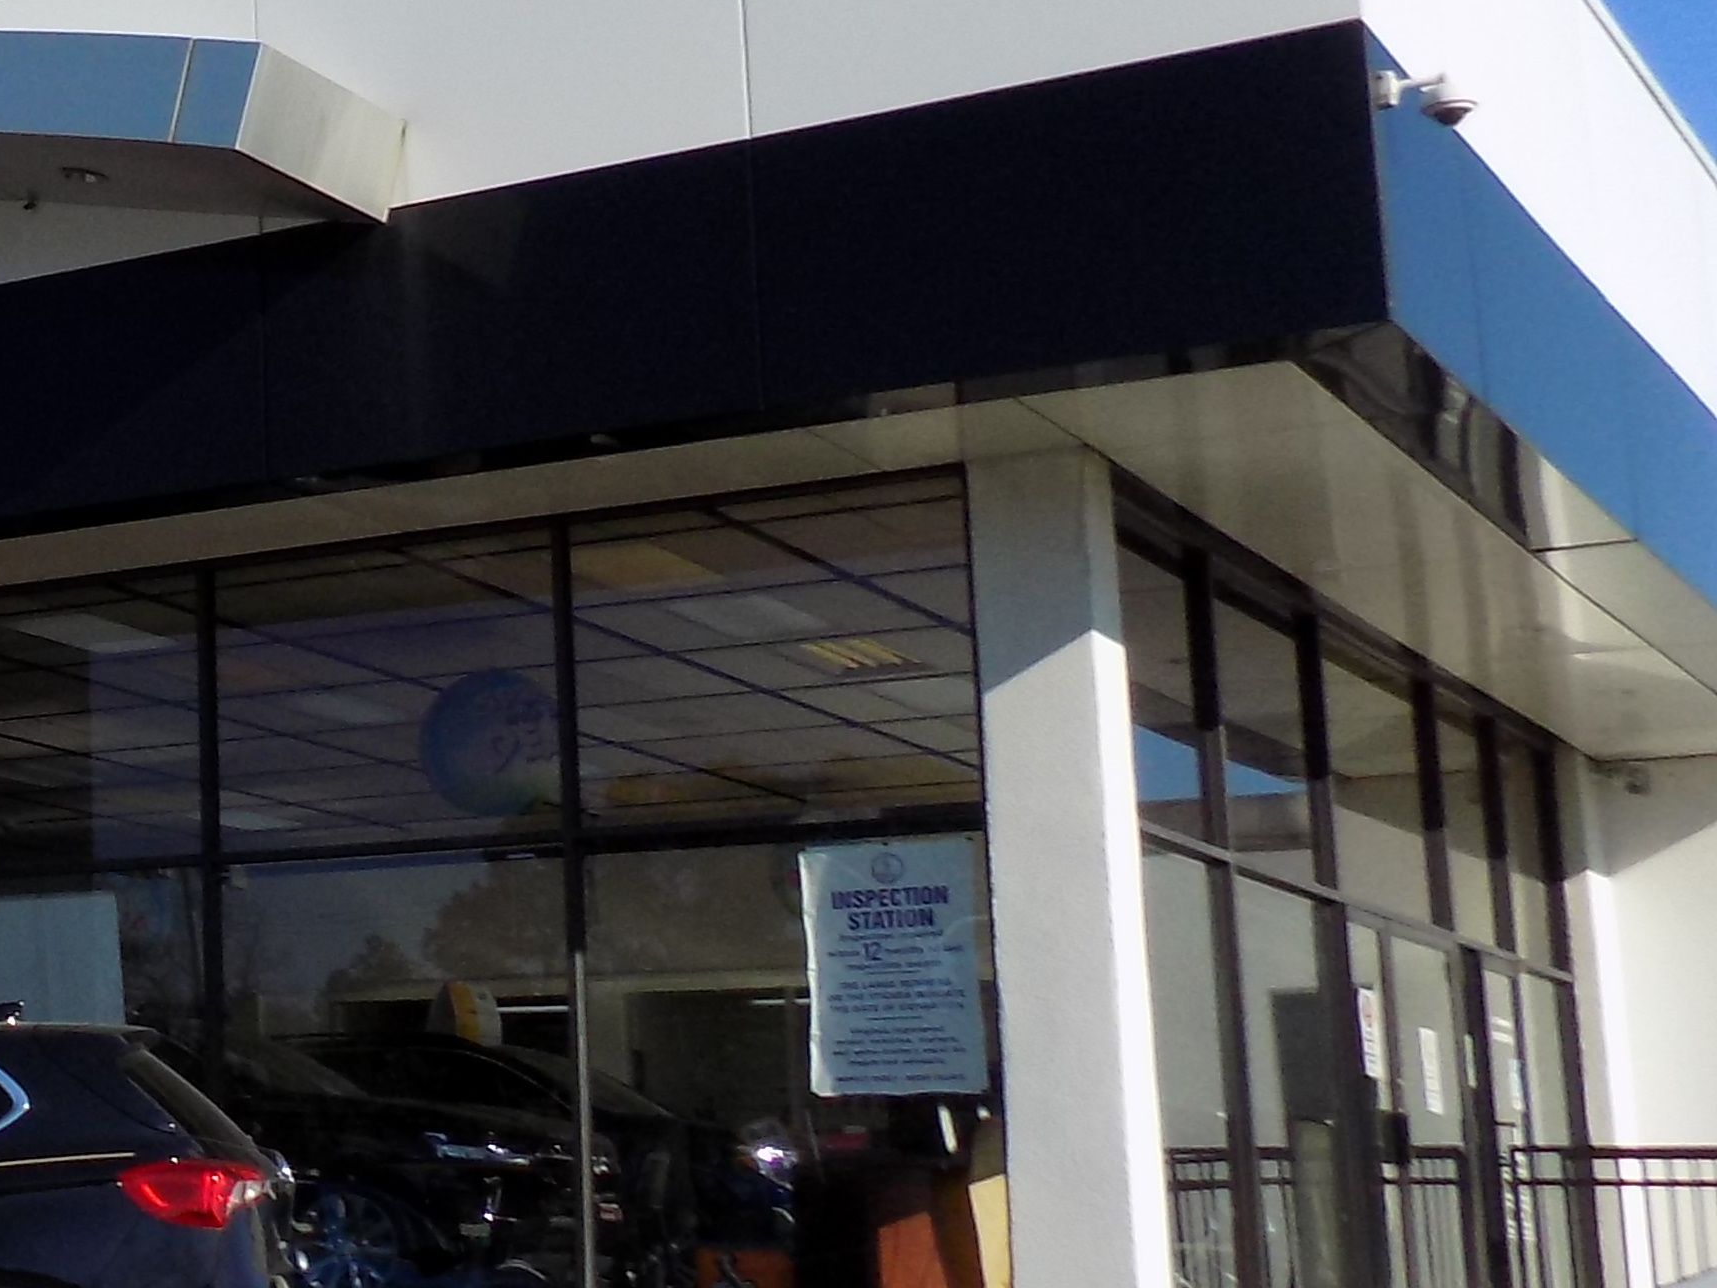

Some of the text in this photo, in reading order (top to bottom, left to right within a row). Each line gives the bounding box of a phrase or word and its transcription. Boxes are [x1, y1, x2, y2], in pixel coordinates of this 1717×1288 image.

[831, 885, 949, 909] INSPECTION
[848, 909, 935, 931] STATION
[863, 941, 883, 961] 12
